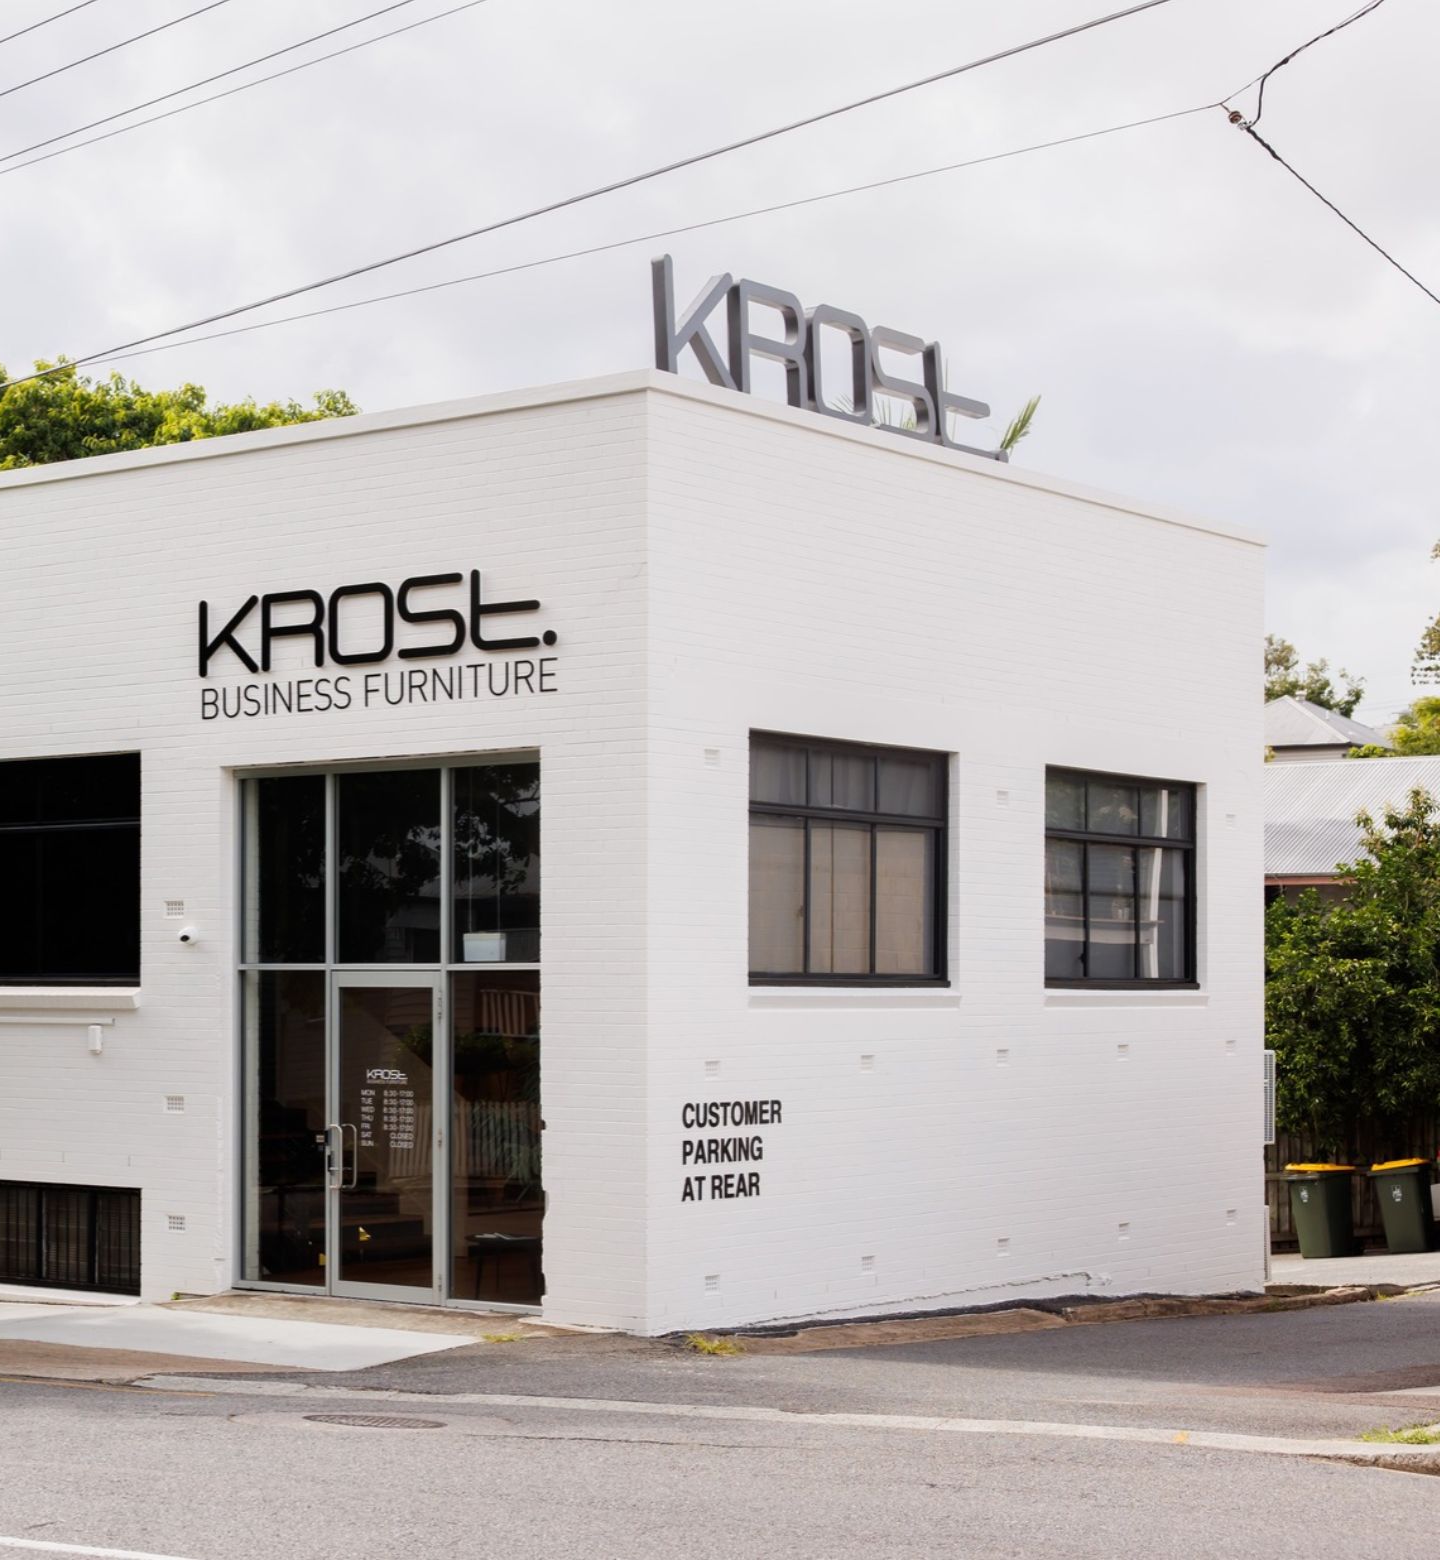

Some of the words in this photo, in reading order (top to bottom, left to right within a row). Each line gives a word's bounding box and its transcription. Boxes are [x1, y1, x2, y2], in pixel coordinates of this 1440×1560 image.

[201, 675, 352, 721] BUSINESS
[364, 657, 558, 707] FURNITURE
[682, 1099, 782, 1129] CUSTOMER
[361, 1139, 374, 1147] SUN
[390, 1141, 414, 1149] CLOSED
[390, 1132, 414, 1140] CLOSED
[682, 1136, 763, 1166] PARKING
[681, 1175, 707, 1202] AT
[711, 1172, 760, 1200] REAR
